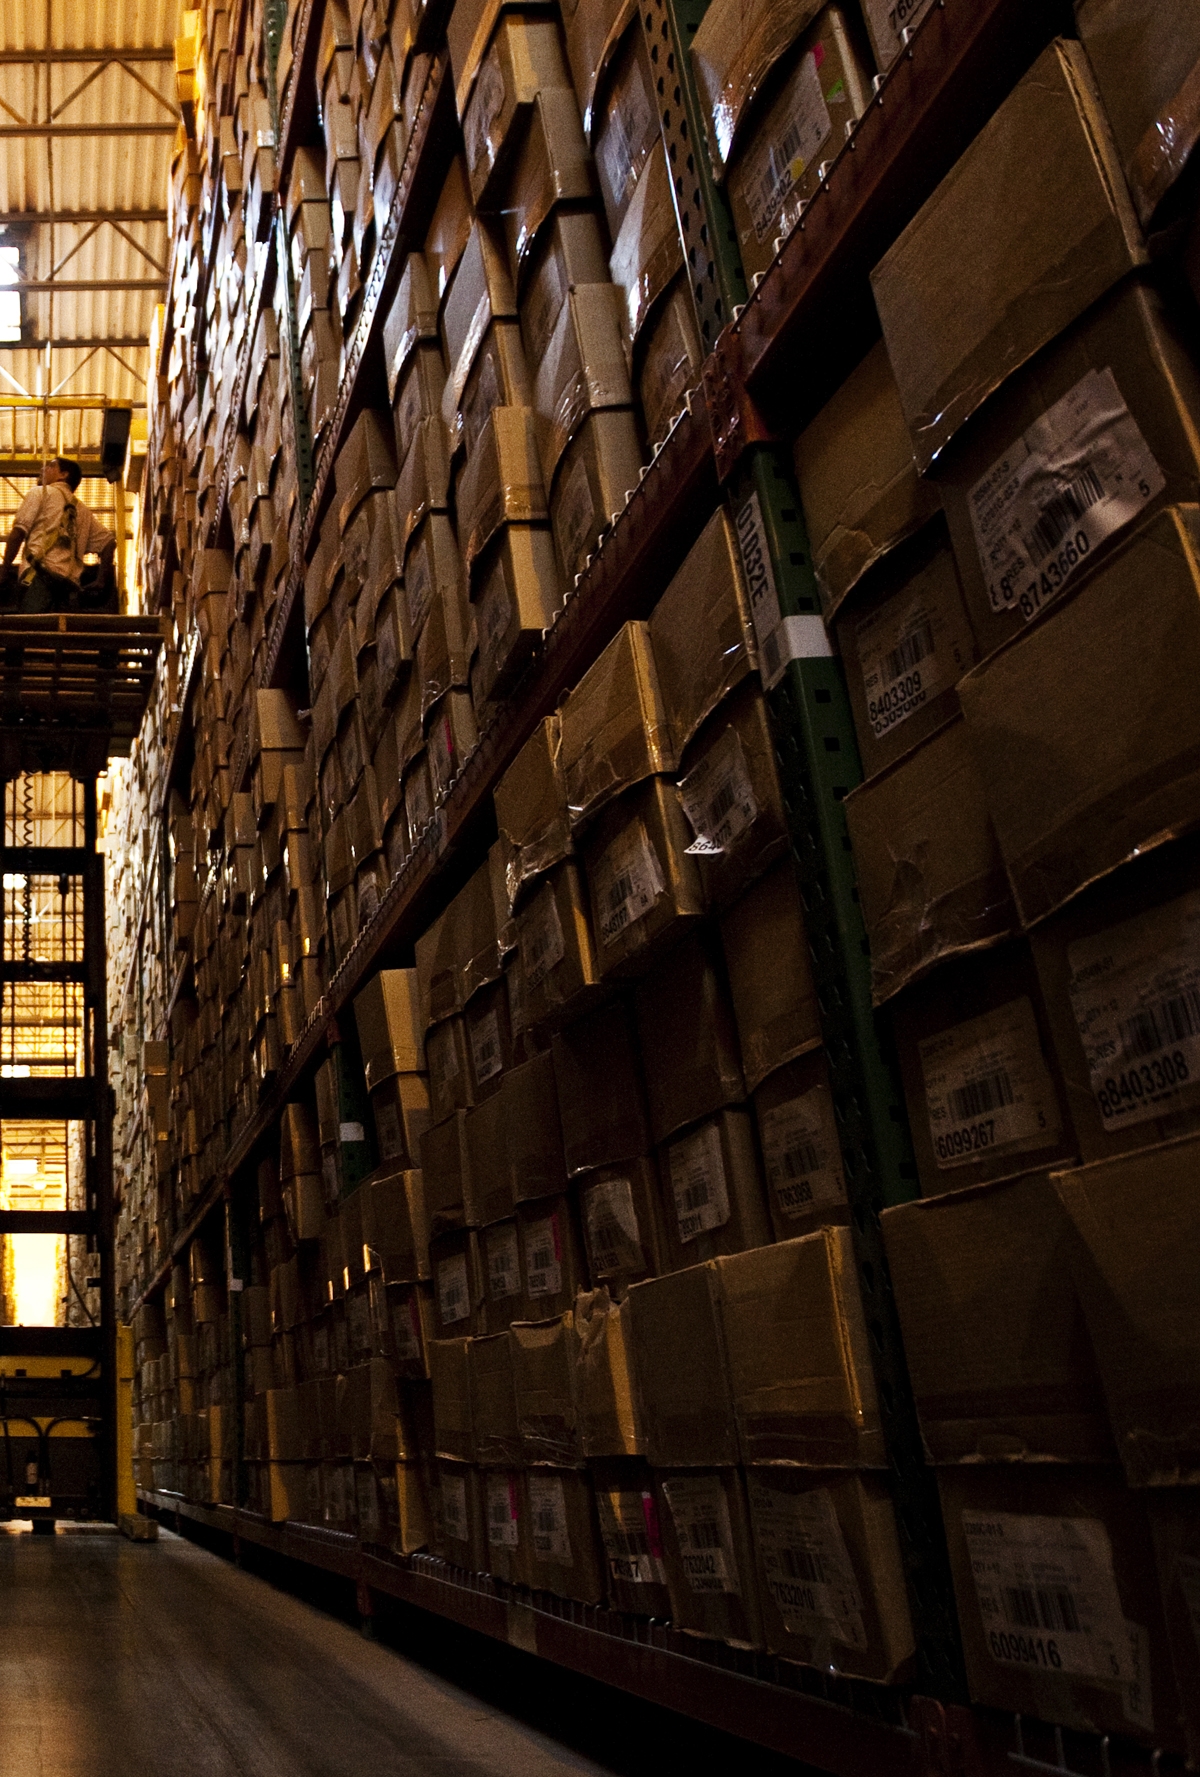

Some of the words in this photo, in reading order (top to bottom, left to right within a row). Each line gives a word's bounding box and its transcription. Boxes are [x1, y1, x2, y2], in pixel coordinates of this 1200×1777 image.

[1138, 479, 1150, 498] 5
[738, 503, 769, 608] 01032E
[1019, 530, 1090, 618] 8743660
[869, 670, 922, 722] 8403309
[1105, 1051, 1189, 1106] 8403308
[938, 1119, 996, 1159] 6099267
[1037, 1111, 1047, 1129] 5
[989, 1630, 1063, 1669] 6099416
[1110, 1654, 1120, 1676] 5
